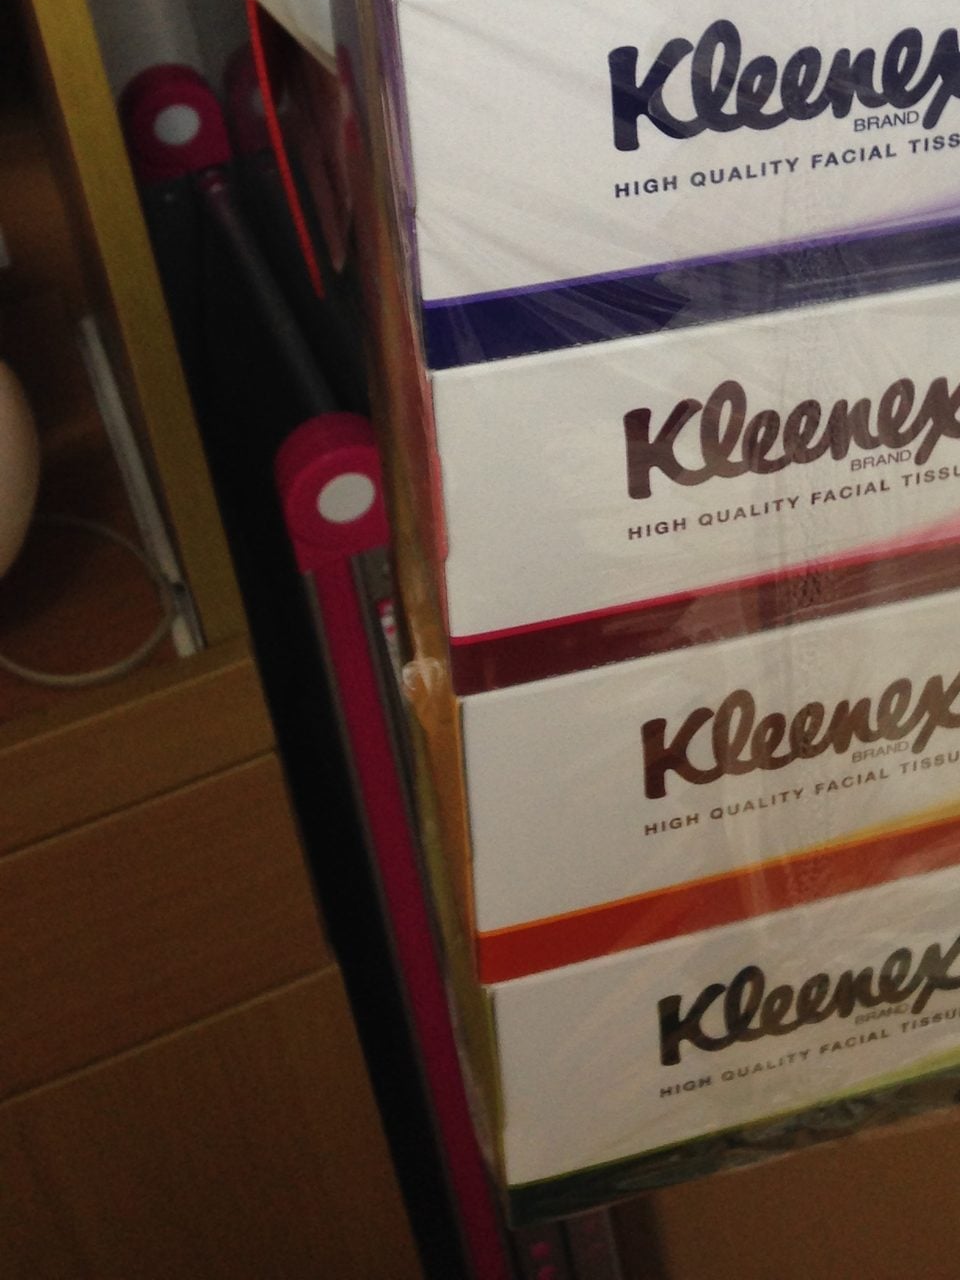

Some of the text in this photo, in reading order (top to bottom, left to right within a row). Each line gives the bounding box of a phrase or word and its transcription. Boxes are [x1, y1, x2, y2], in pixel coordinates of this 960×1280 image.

[854, 110, 919, 132] BRAND
[615, 176, 678, 198] HIGH
[690, 158, 799, 187] QUALITY
[812, 145, 896, 169] FACIAL
[851, 450, 911, 471] BRAND
[629, 518, 687, 540] HIGH
[698, 496, 799, 526] QUALITY
[811, 480, 890, 505] FACIAL
[852, 741, 909, 763] BRAND
[645, 813, 699, 836] HIGH
[710, 788, 804, 820] QUALITY
[815, 769, 888, 795] FACIAL
[660, 1076, 711, 1098] HIGH
[722, 1050, 809, 1081] QUALITY
[820, 1029, 888, 1054] FACIAL
